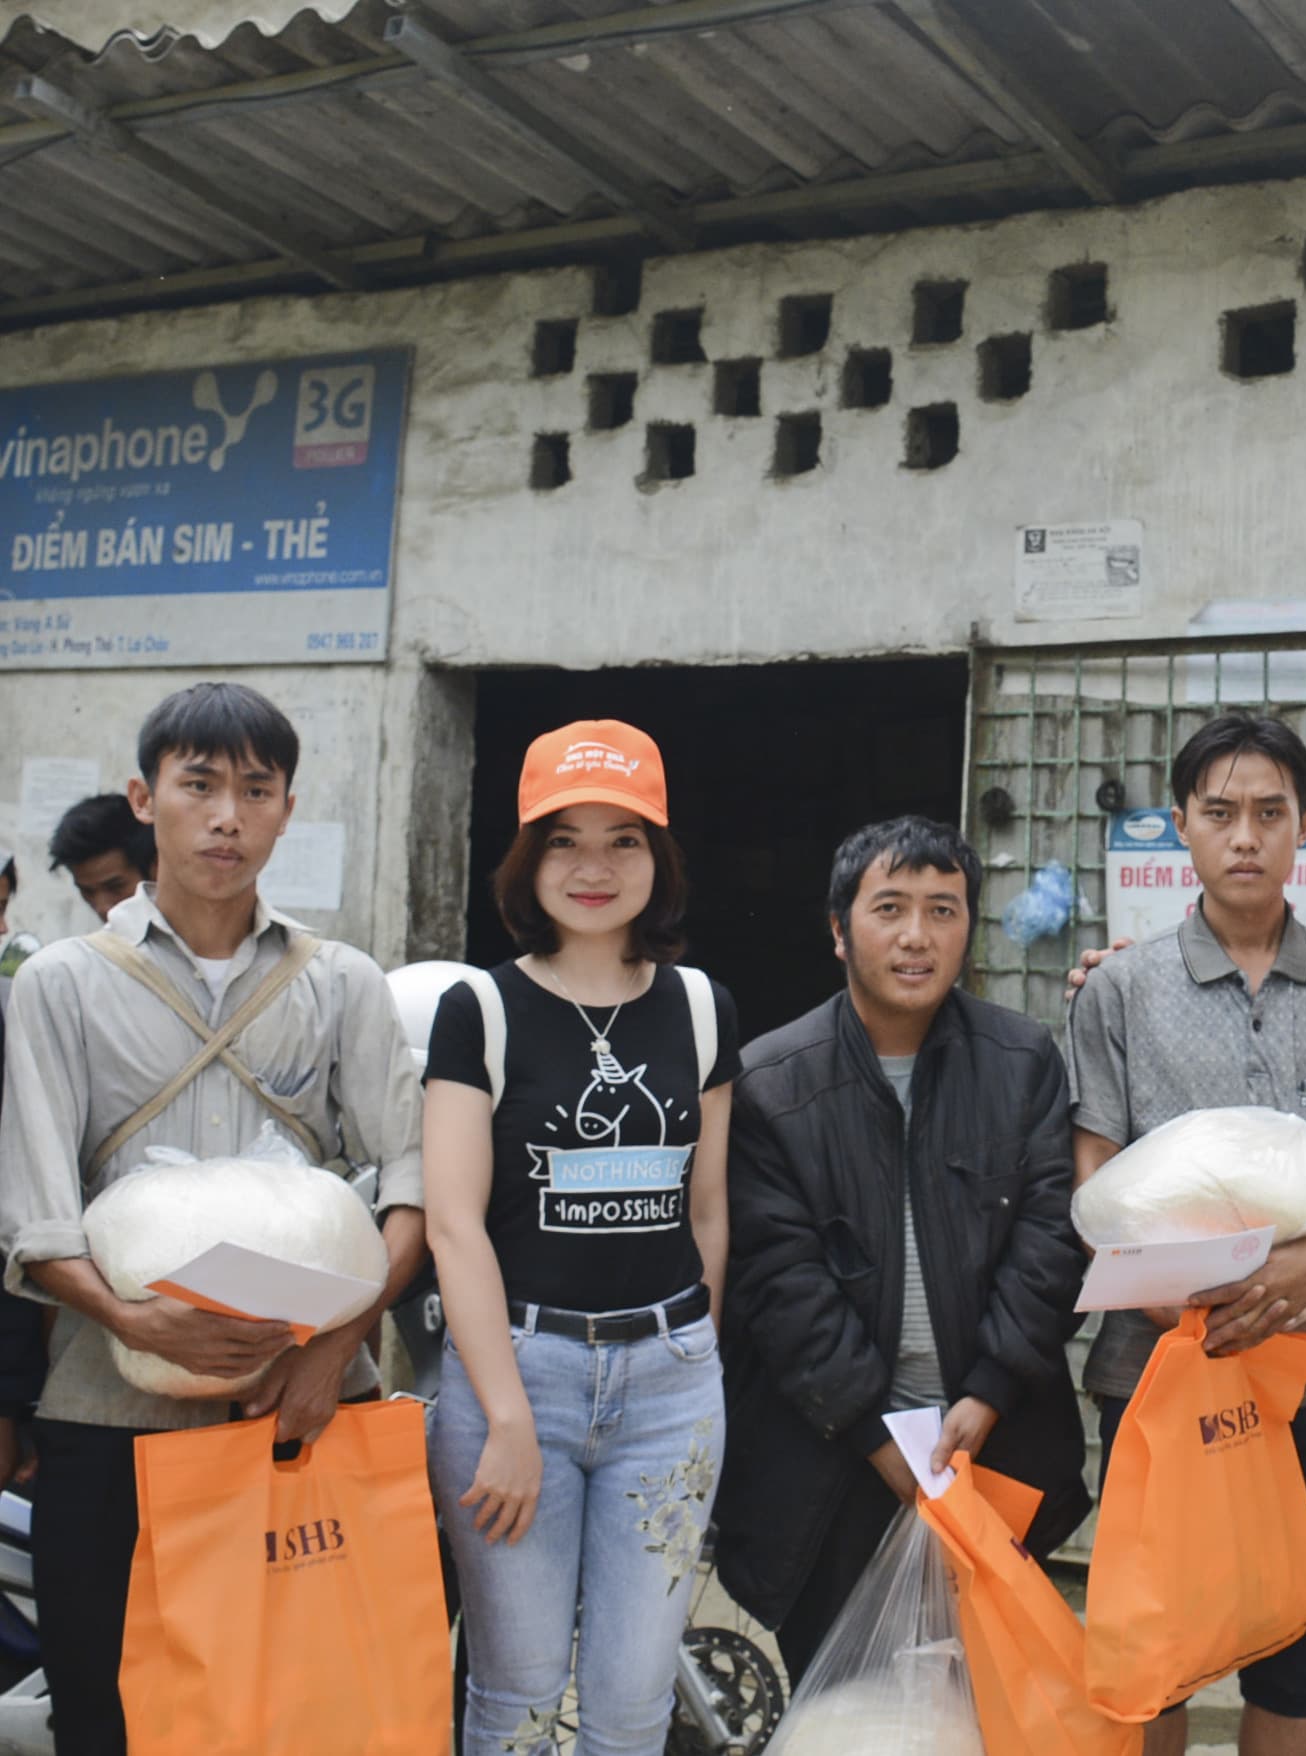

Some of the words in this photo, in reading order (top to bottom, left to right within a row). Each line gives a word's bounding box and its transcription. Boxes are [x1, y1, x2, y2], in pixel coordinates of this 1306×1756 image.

[304, 379, 364, 431] 3G
[12, 509, 88, 571] ĐIỂM
[96, 517, 164, 567] BÁN
[173, 523, 233, 563] SIM
[264, 500, 329, 560] THẺ
[562, 1160, 662, 1182] NOTHING
[284, 1518, 344, 1560] SHB
